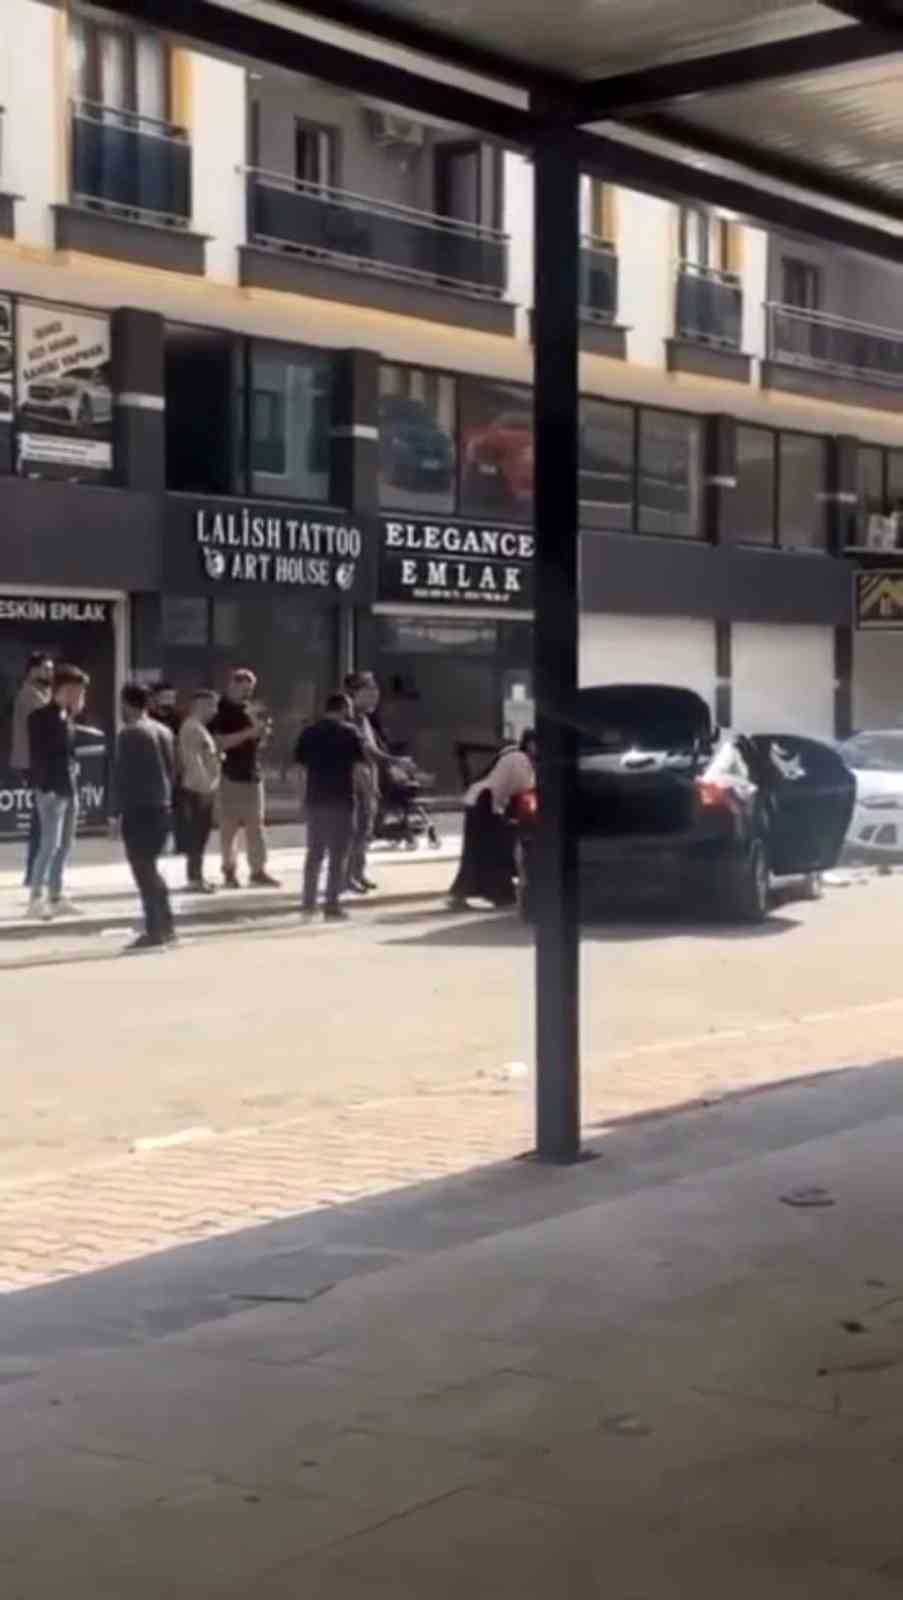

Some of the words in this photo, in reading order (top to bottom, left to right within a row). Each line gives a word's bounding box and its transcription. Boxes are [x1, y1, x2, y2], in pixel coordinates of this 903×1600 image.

[197, 508, 281, 549] LALİSH
[286, 520, 361, 558] TATTOO
[385, 522, 536, 558] ELEGANCE
[231, 552, 271, 583] ART
[276, 555, 330, 587] HOUSE
[401, 559, 521, 592] EMLAK
[49, 602, 105, 621] EMLAK
